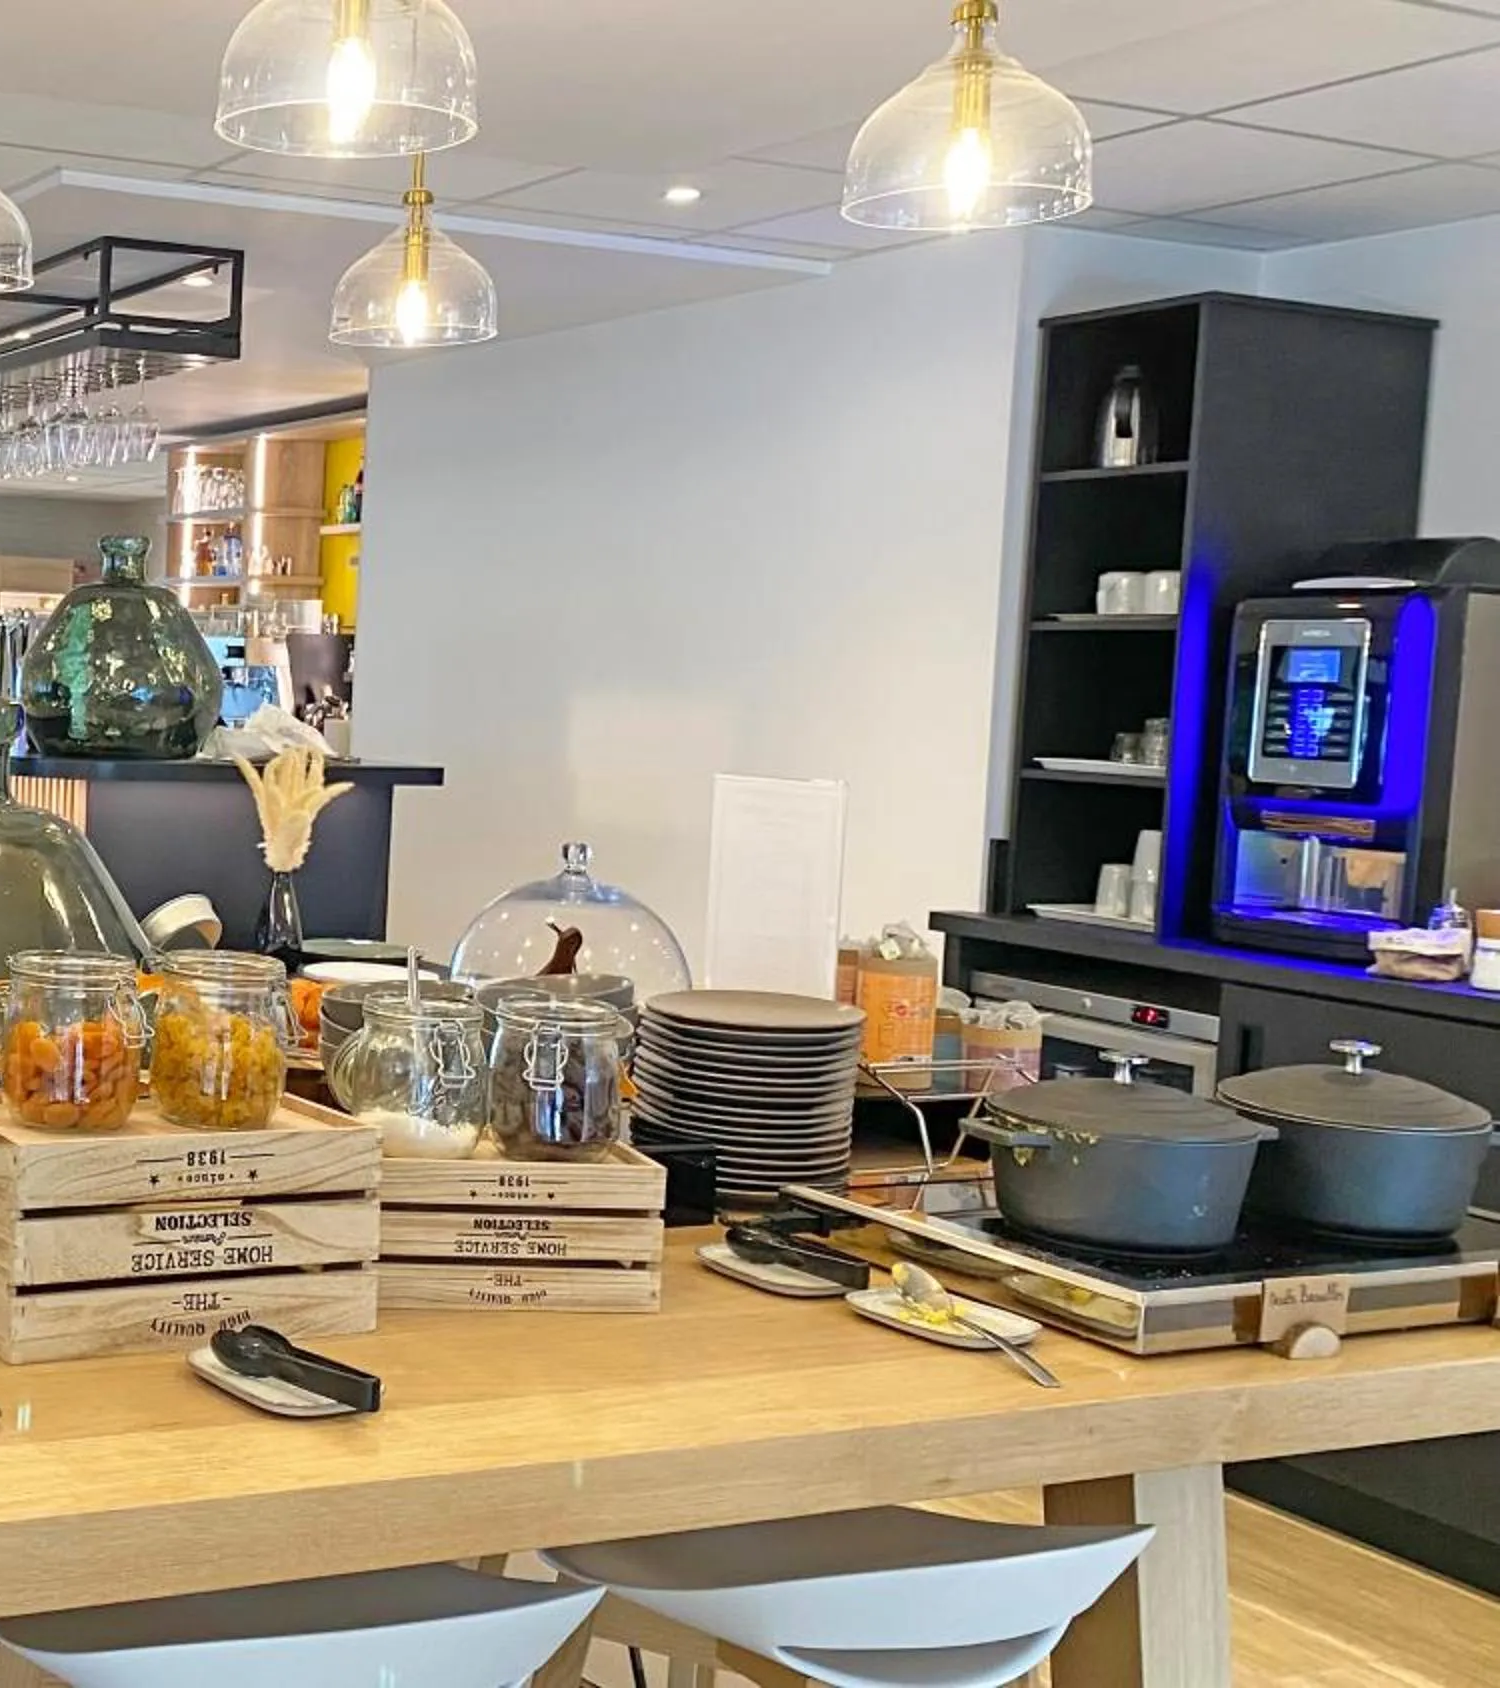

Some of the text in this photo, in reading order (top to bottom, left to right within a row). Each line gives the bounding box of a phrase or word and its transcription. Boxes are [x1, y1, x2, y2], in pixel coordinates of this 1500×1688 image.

[186, 1149, 227, 1167] 1938
[498, 1174, 531, 1188] 1938
[154, 1210, 254, 1232] SELECTION
[472, 1218, 552, 1232] SELECTION
[453, 1239, 568, 1257] HOME SERVICE
[130, 1244, 274, 1273] HOME SERVICE
[150, 1317, 206, 1337] QUALITY
